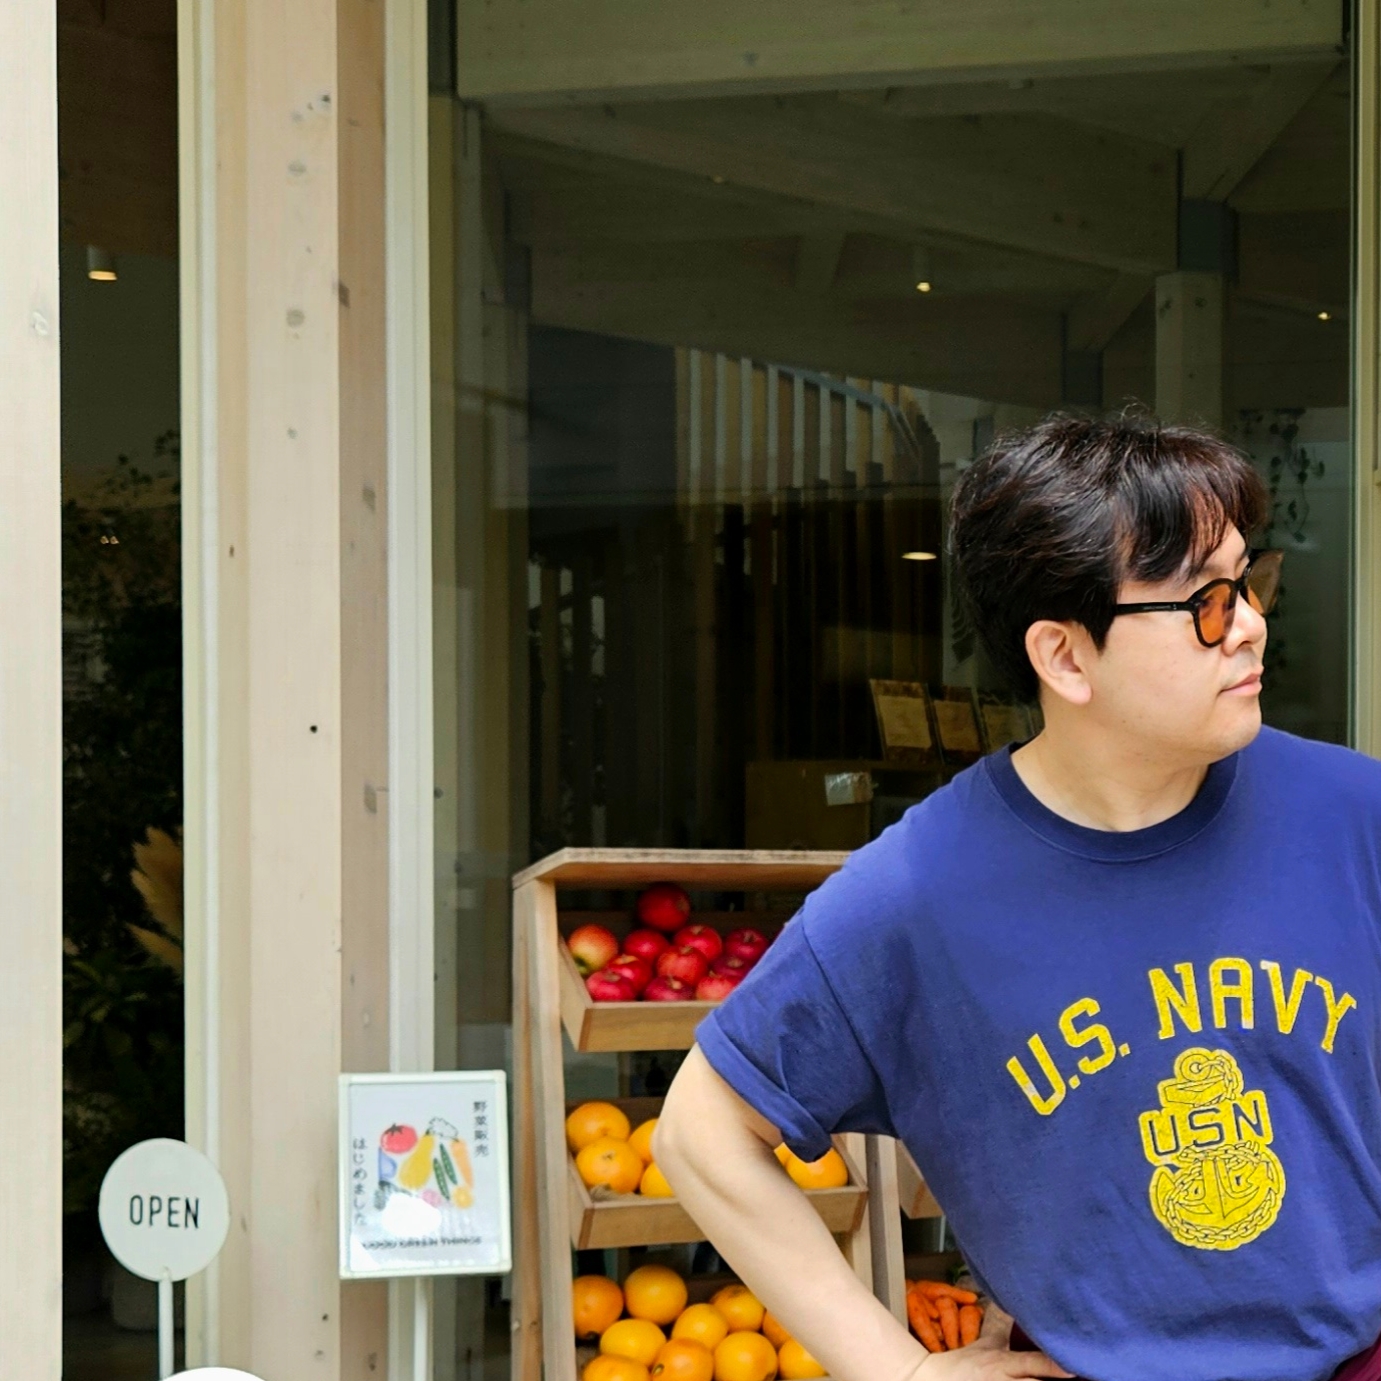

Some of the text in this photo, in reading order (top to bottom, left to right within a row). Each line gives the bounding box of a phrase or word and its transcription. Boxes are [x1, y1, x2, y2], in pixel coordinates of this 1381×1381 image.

[1006, 957, 1357, 1115] U.S. NAVY
[473, 1101, 489, 1157] 野菜販売
[1143, 1093, 1271, 1160] USN
[128, 1195, 200, 1229] OPEN
[352, 1138, 367, 1226] はじめました
